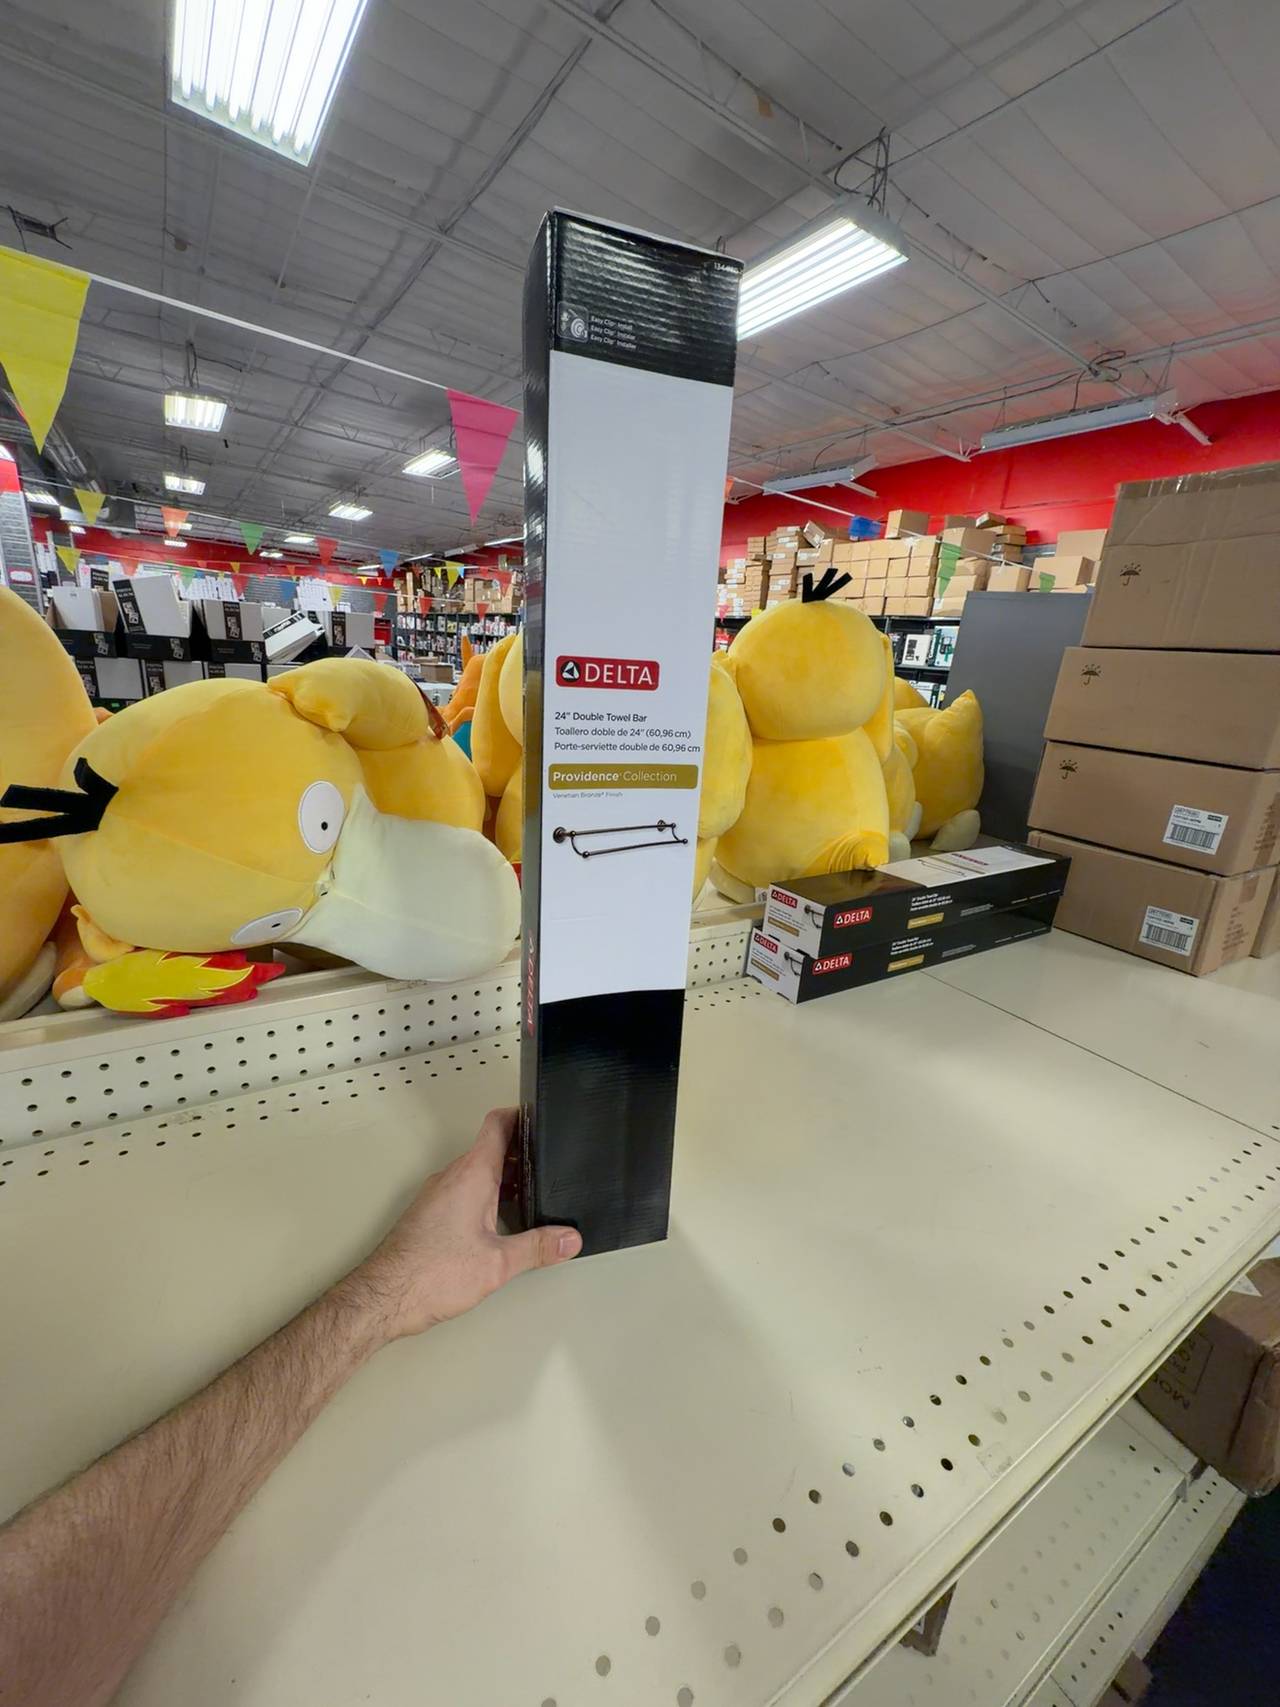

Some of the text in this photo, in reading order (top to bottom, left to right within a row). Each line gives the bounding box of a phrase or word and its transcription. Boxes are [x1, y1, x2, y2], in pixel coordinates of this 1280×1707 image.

[584, 662, 653, 685] DELTA
[572, 711, 605, 721] Double
[606, 712, 631, 722] Towel
[632, 713, 648, 723] Bar
[554, 726, 590, 736] Toallero
[591, 727, 616, 737] doble
[617, 727, 629, 737] de
[646, 728, 674, 739] (60,96
[674, 729, 692, 740] cm)
[554, 742, 701, 753] Porte-serviette double de 60,96 cm
[622, 770, 677, 782] Collection
[843, 909, 872, 924] DELTA
[822, 956, 850, 970] DELTA
